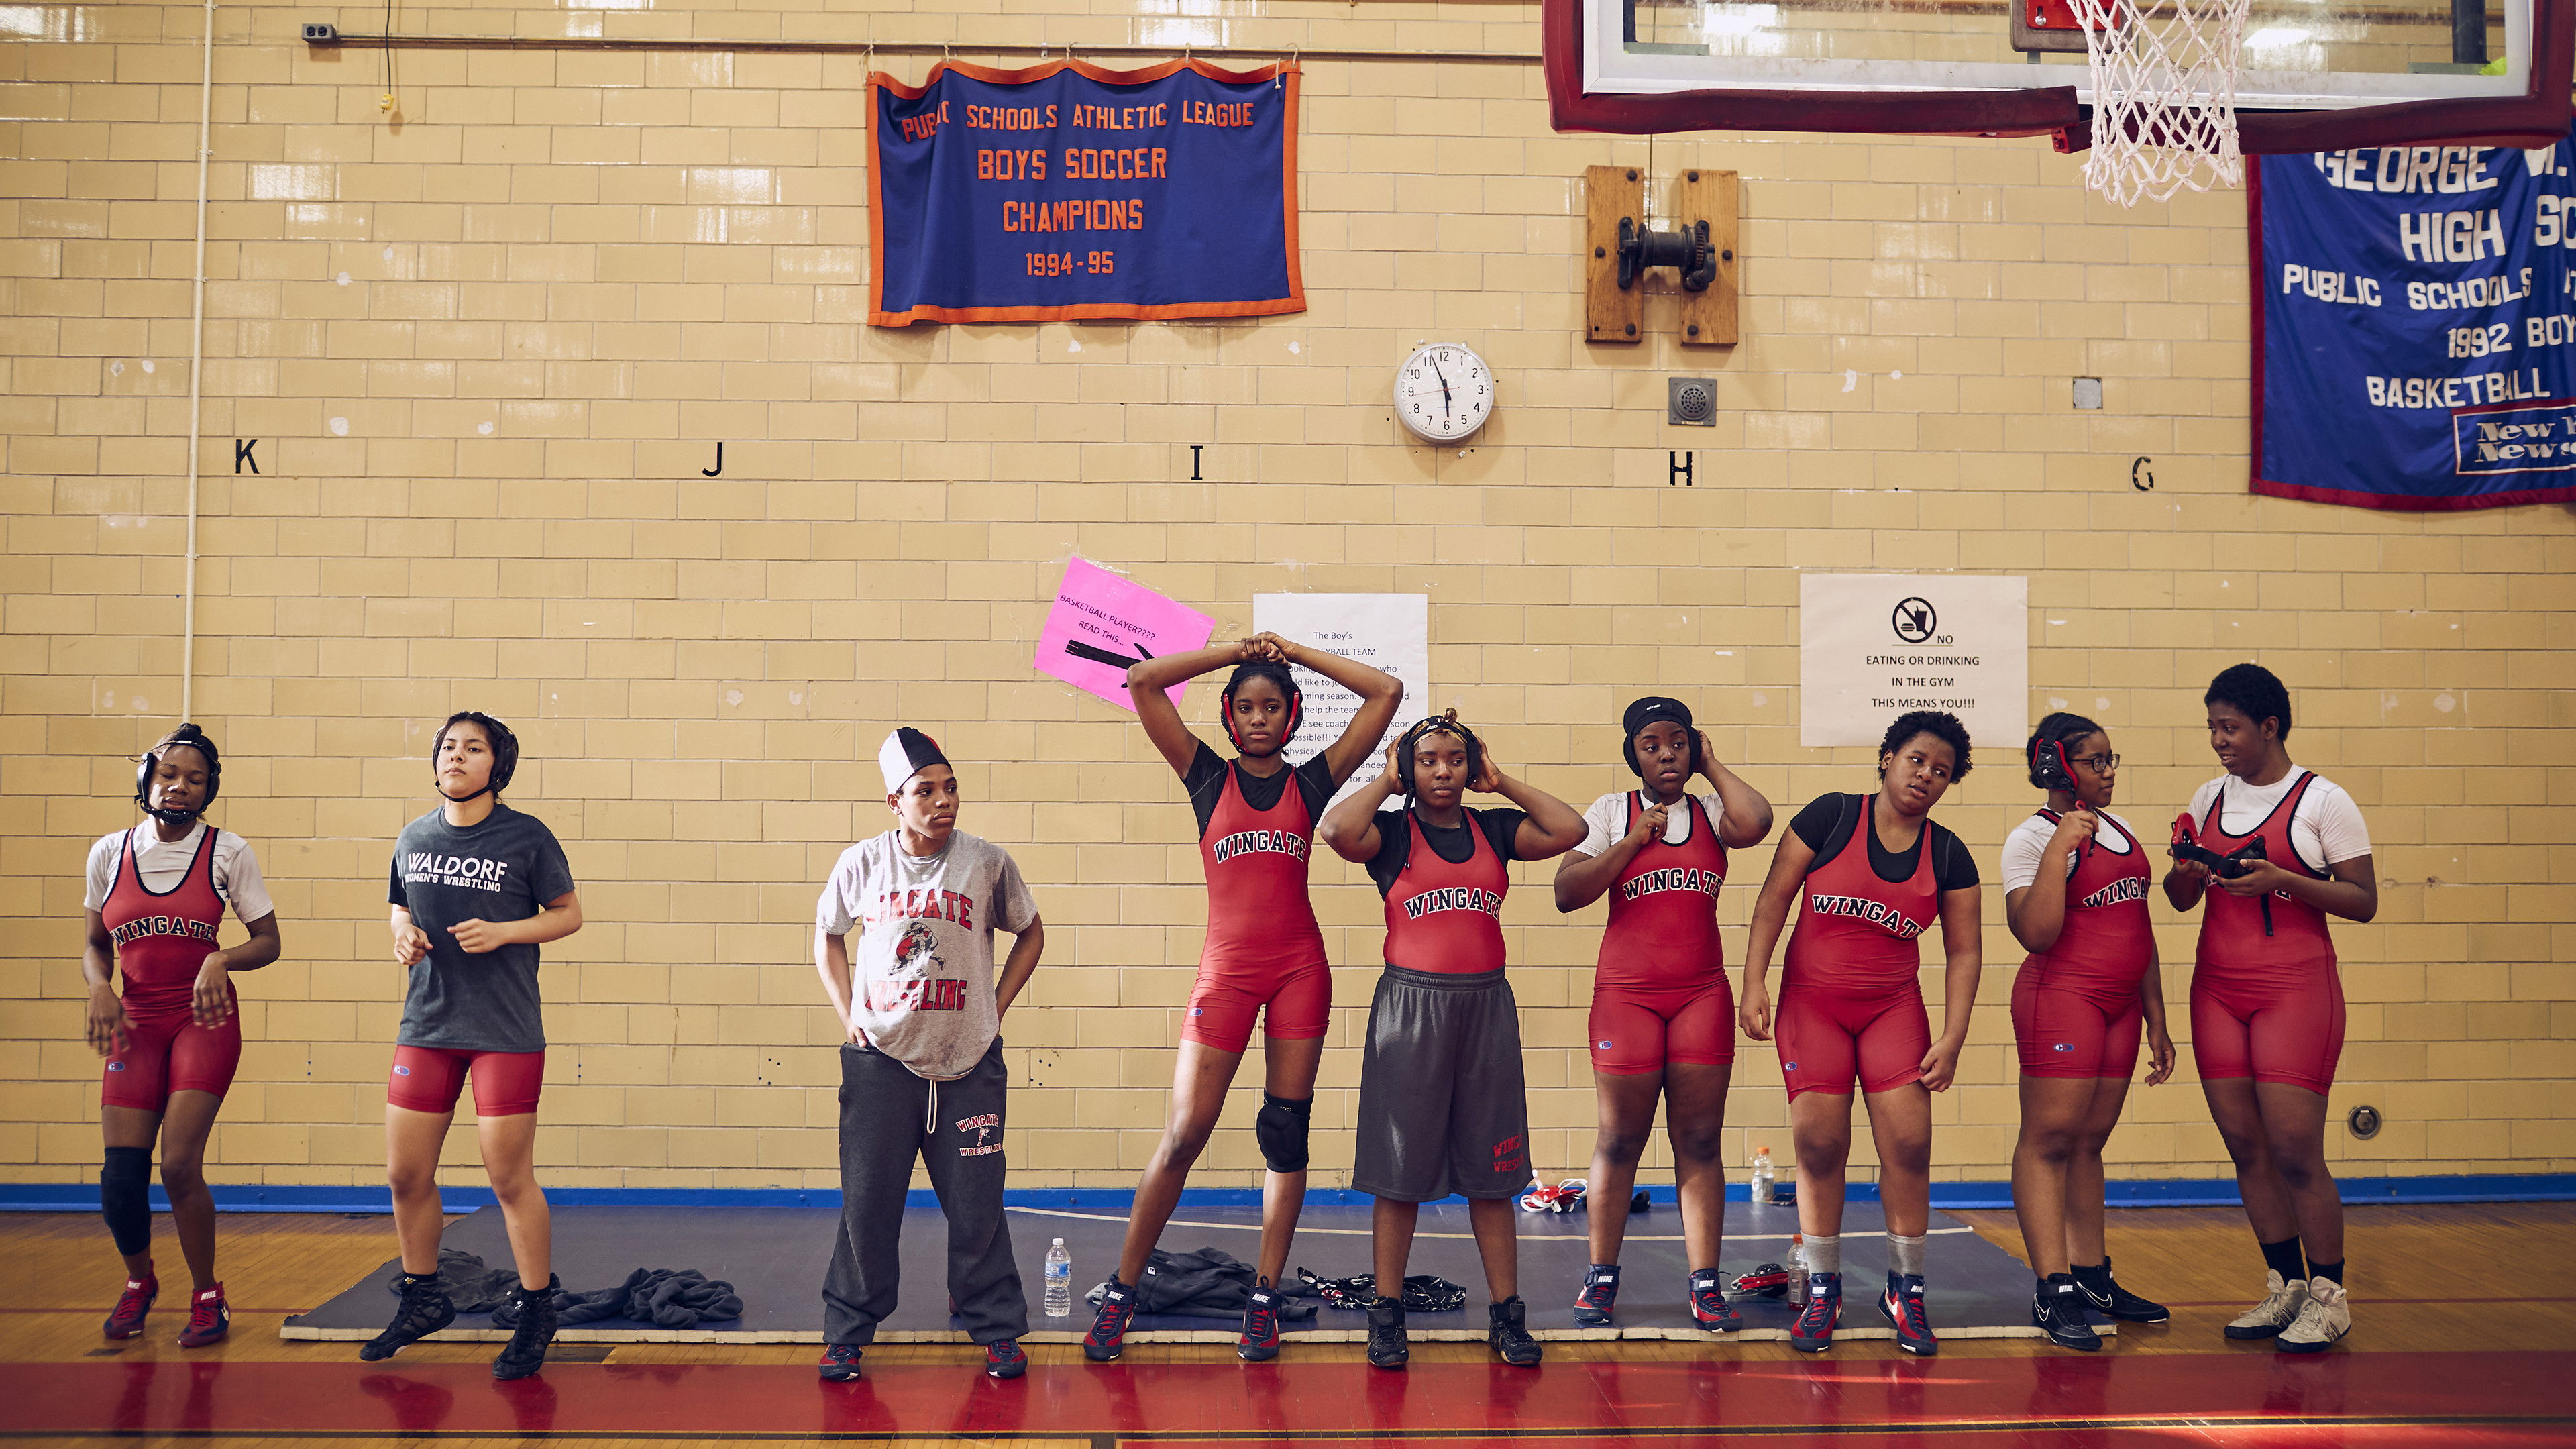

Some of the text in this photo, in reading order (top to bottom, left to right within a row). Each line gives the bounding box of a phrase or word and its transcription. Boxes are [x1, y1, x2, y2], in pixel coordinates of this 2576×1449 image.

[967, 105, 1058, 131] SCHOOLS
[1073, 103, 1167, 131] ATHLETIC
[1183, 100, 1254, 127] LEAGUE
[977, 148, 1167, 180] BOYS SOCCER
[1004, 199, 1144, 233] CHAMPIONS
[2400, 209, 2506, 263] HIGH
[2283, 264, 2382, 307] PUBLIC
[2407, 267, 2532, 310] SCHOOLS
[2447, 323, 2512, 358] 1992
[1424, 356, 1432, 366] 11
[1440, 351, 1449, 362] 12
[1411, 369, 1420, 380] 10
[1472, 368, 1478, 378] 2
[1408, 387, 1414, 397] 9
[1478, 385, 1484, 395] 3
[2366, 368, 2551, 409] BASKETBALL
[1413, 403, 1420, 414] 8
[1473, 402, 1480, 413] 4
[1427, 415, 1433, 426] 7
[1444, 420, 1450, 431] 6
[1461, 415, 1467, 425] 5
[2477, 422, 2555, 442] New
[235, 439, 260, 474] K
[702, 441, 723, 477] J
[1190, 445, 1203, 480] I
[1670, 451, 1693, 486] H
[2132, 456, 2154, 492] G
[1060, 594, 1156, 641] BASKETBALL PLAYER????
[1078, 620, 1124, 646] READ THIS...
[1313, 631, 1352, 641] The Boy's
[1937, 635, 1953, 644] NO
[1866, 655, 1980, 666] EATING OR DRINKING
[1892, 678, 1954, 687] IN THE GYM
[1872, 698, 1975, 708] THIS MEANS YOU!!!
[1305, 706, 1323, 714] help
[1293, 733, 1331, 741] ossible!!!
[1366, 775, 1375, 783] all
[1214, 830, 1307, 864] WINGATE
[408, 853, 508, 882] WALDORF
[405, 873, 501, 892] WOMEN'S WRESTLING
[2083, 877, 2151, 907] WINGA
[109, 915, 215, 946] WINGATE
[955, 1114, 999, 1132] WINGATE
[959, 1142, 1002, 1157] WRESTLIN
[1597, 1275, 1614, 1283] NIKE
[1699, 1279, 1715, 1289] NIKE
[200, 1290, 217, 1301] NIKE
[1108, 1291, 1124, 1301] NIKE
[1252, 1293, 1270, 1303] NIKE
